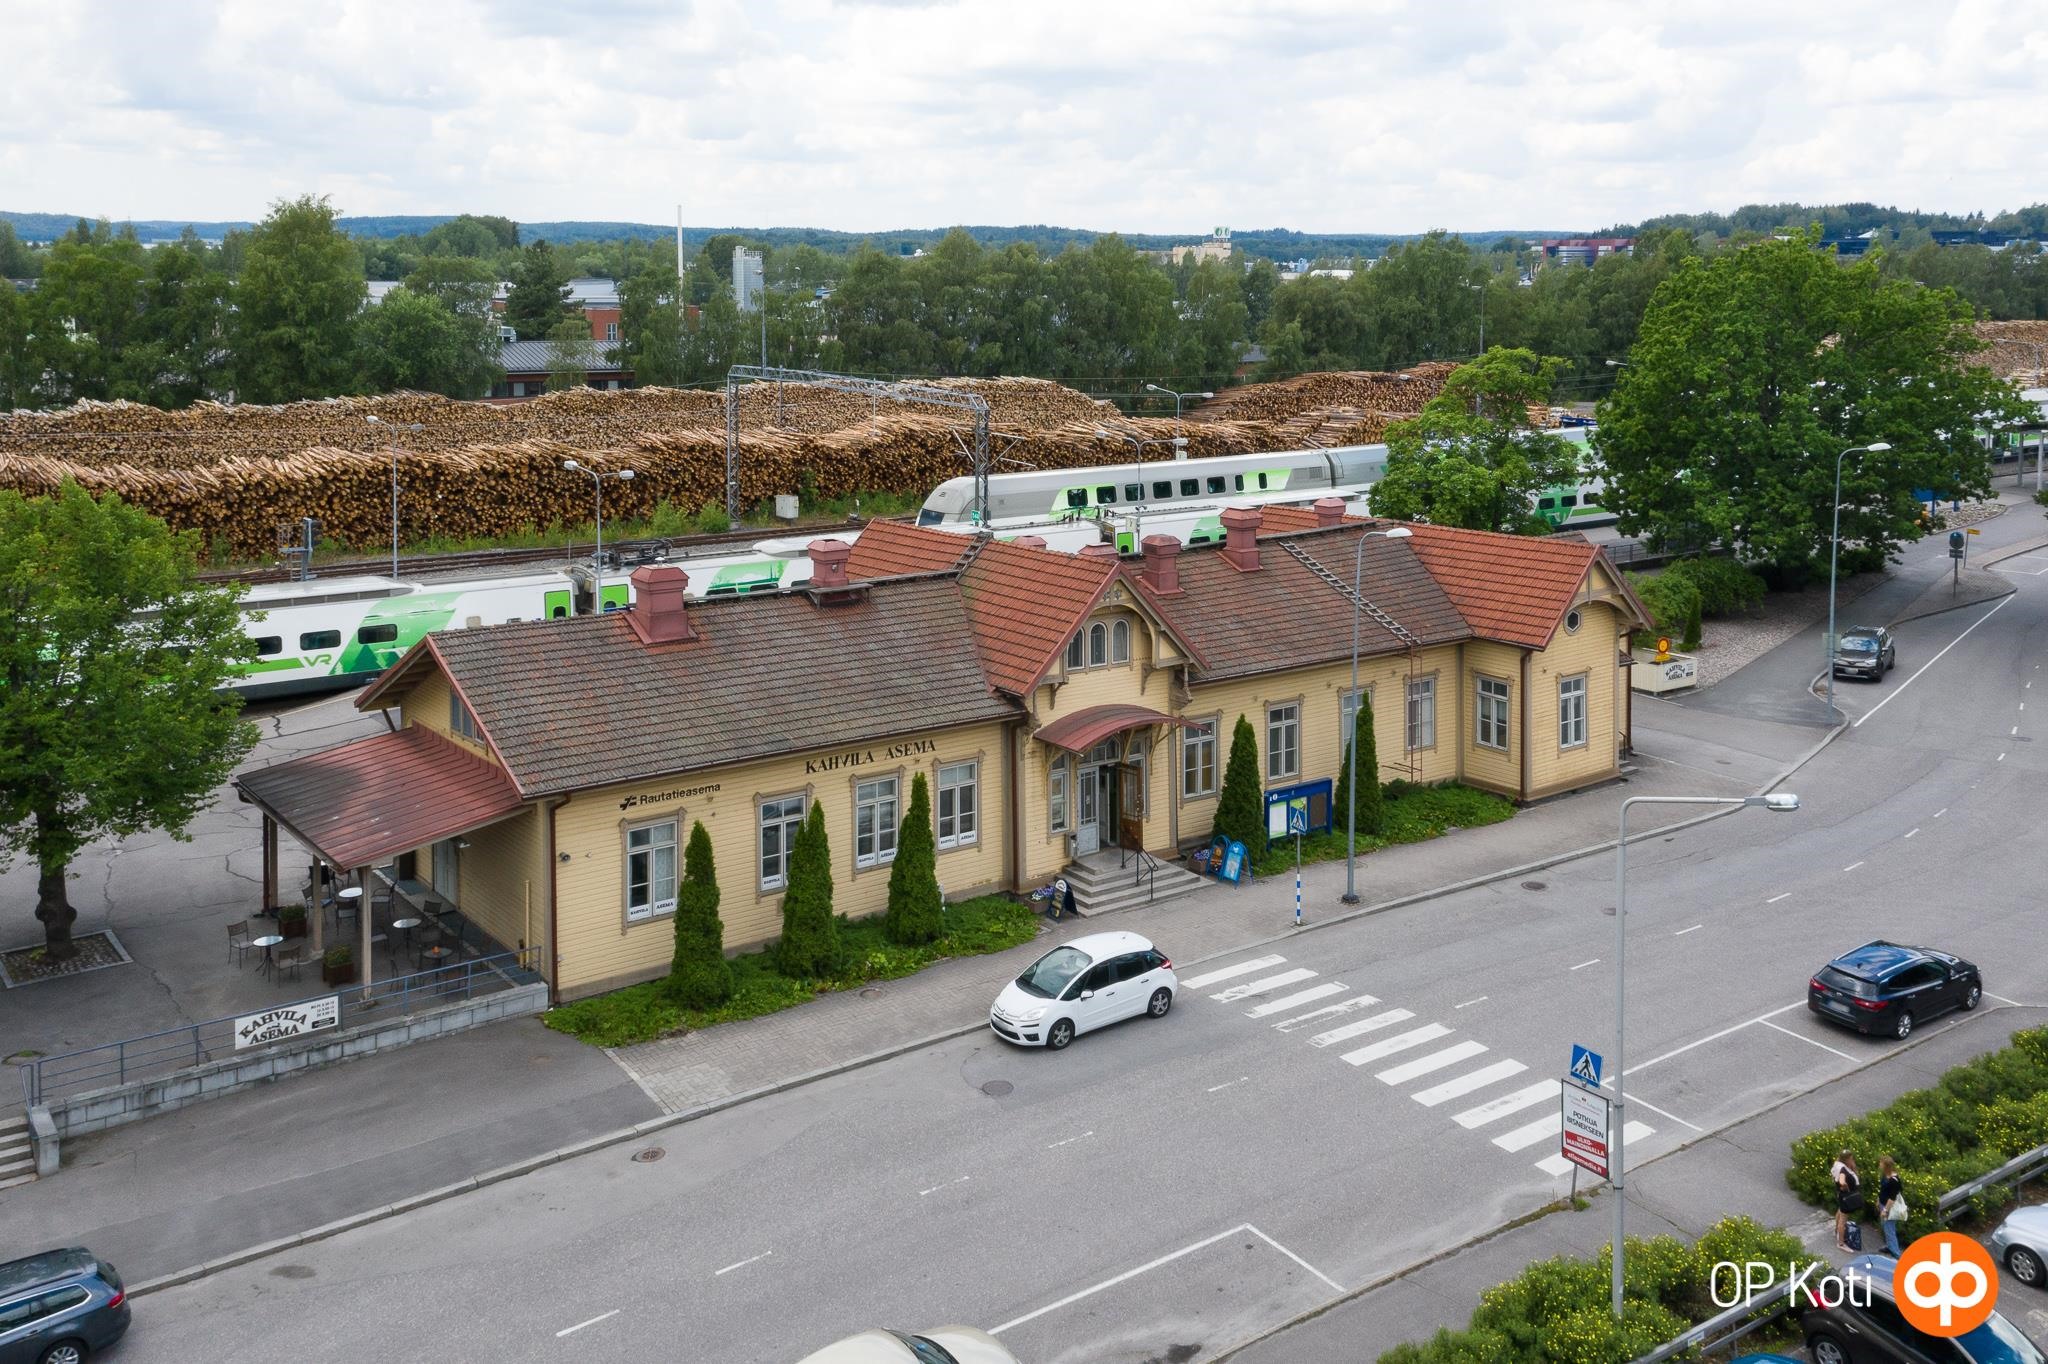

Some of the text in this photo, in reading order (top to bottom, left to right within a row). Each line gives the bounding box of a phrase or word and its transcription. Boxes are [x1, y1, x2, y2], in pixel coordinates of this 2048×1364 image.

[303, 654, 332, 667] VR
[805, 739, 936, 774] KAHVILA ASEMA
[639, 783, 721, 805] Rautatieasema
[239, 1010, 307, 1039] KAHVILA
[249, 1024, 300, 1045] ASEMA
[1566, 1115, 1604, 1139] BISNEKSEEN
